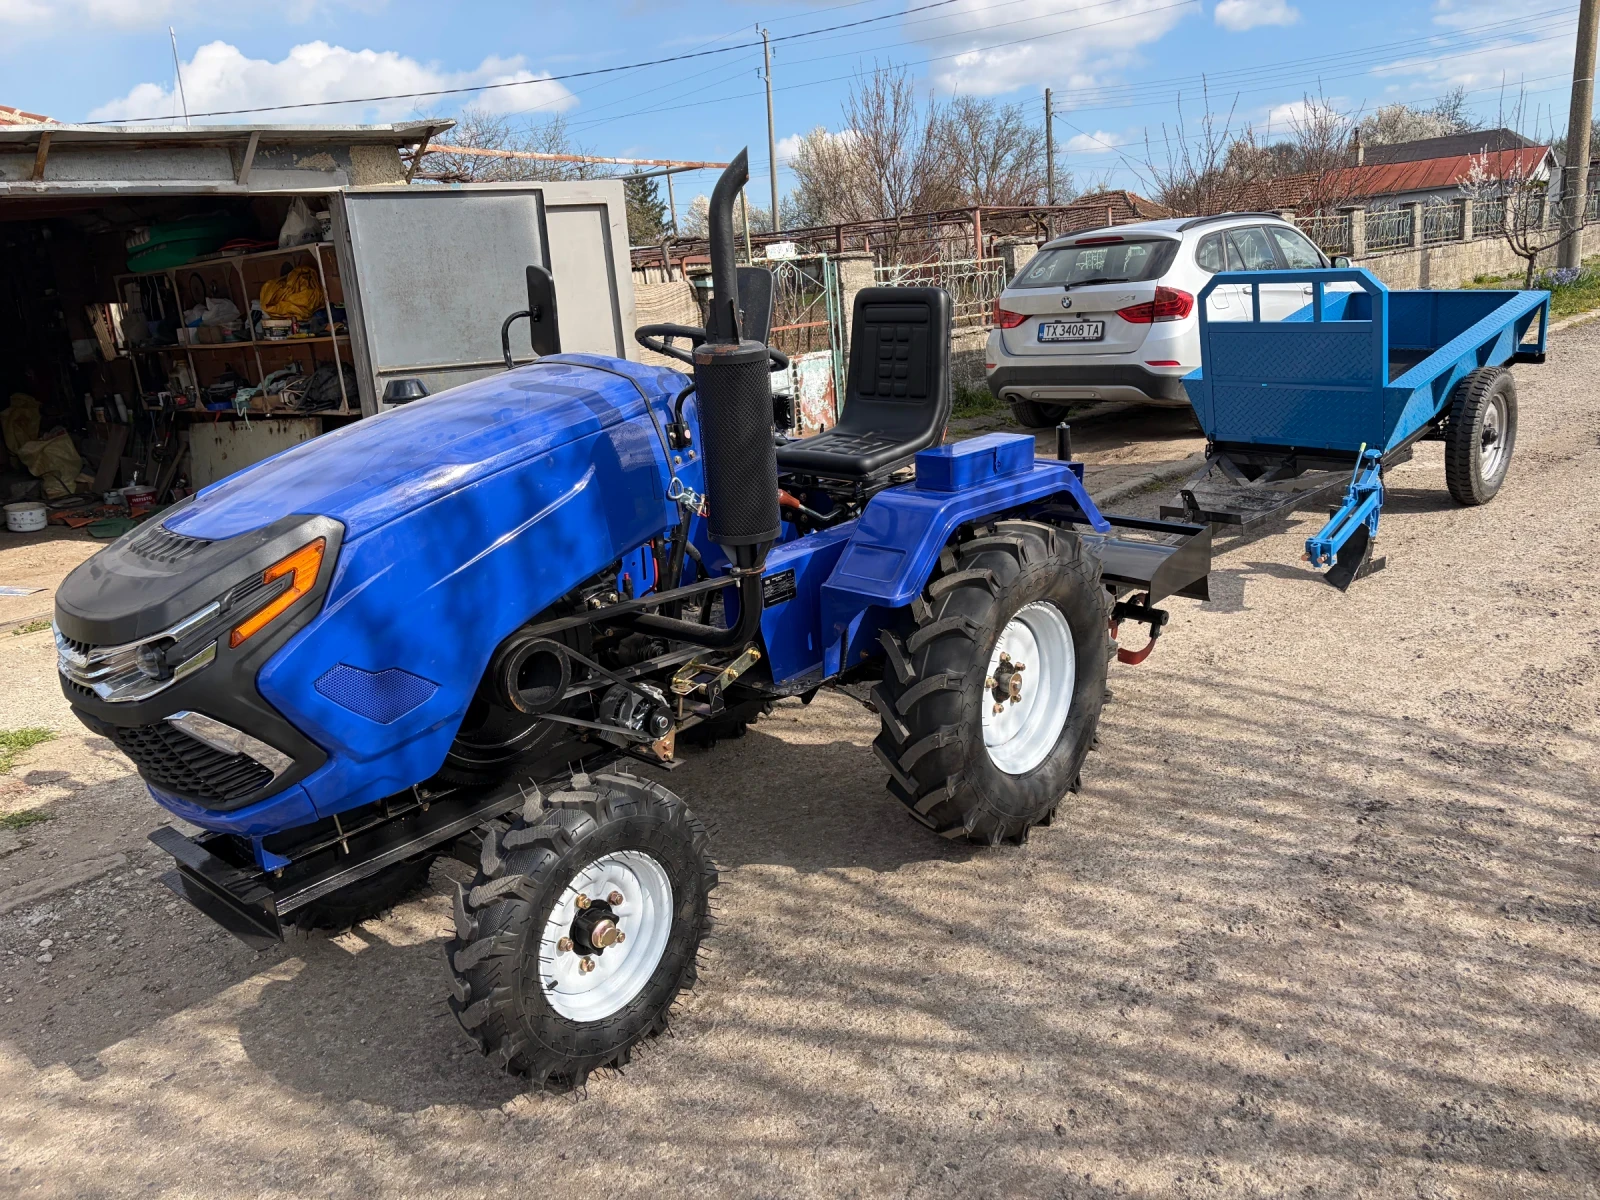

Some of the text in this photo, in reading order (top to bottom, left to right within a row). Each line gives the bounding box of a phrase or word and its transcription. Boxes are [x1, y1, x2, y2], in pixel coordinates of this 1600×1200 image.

[1046, 325, 1058, 337] TX
[1059, 324, 1084, 337] 3408
[1087, 324, 1099, 336] TA
